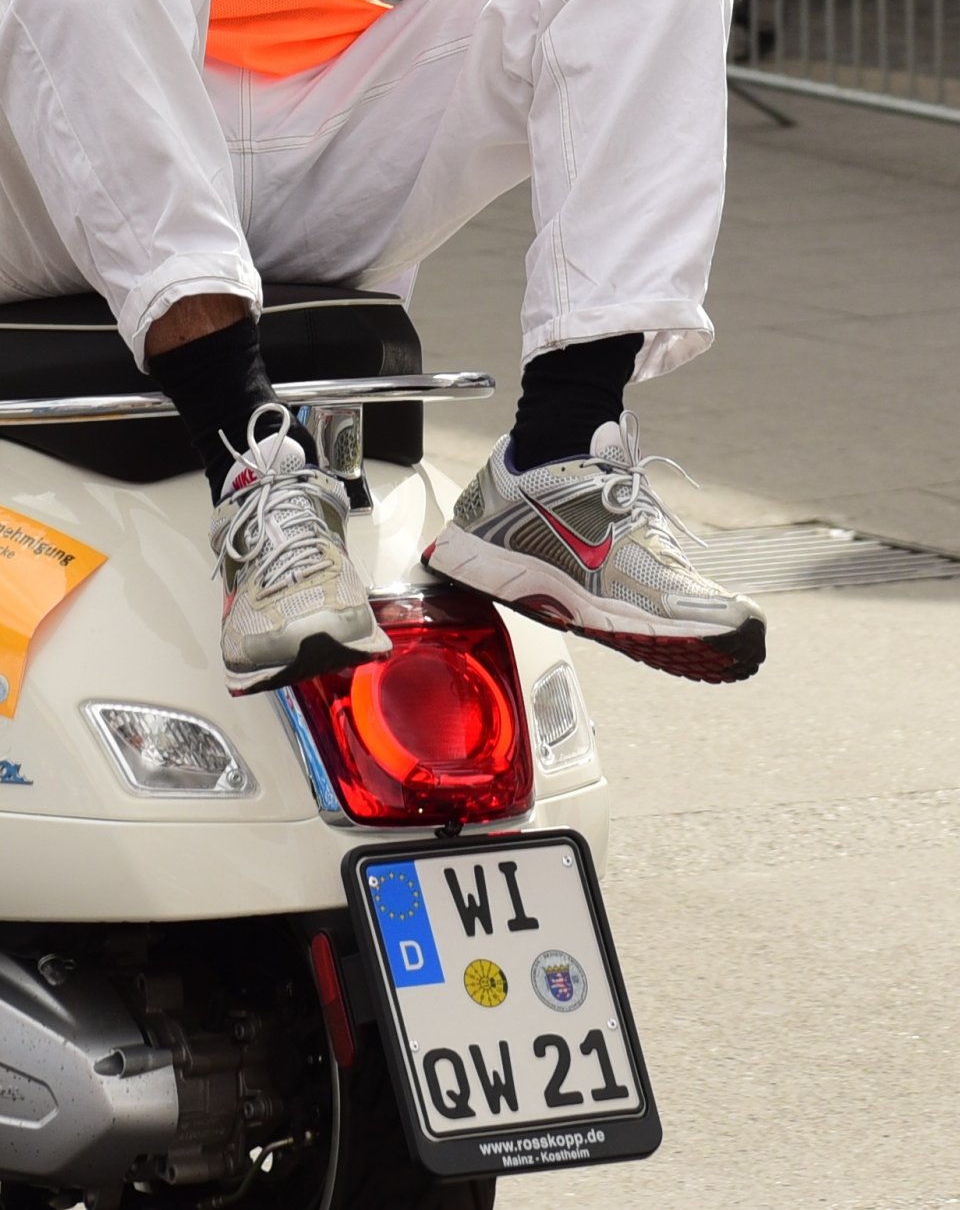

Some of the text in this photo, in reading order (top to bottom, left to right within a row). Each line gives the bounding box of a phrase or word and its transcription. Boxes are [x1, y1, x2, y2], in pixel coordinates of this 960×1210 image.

[443, 861, 540, 937] WI
[399, 940, 425, 972] D
[422, 1029, 630, 1119] QW 21
[479, 1128, 606, 1155] www.rosskopp.de
[502, 1154, 535, 1168] Mainz
[541, 1148, 591, 1163] Kostheim
